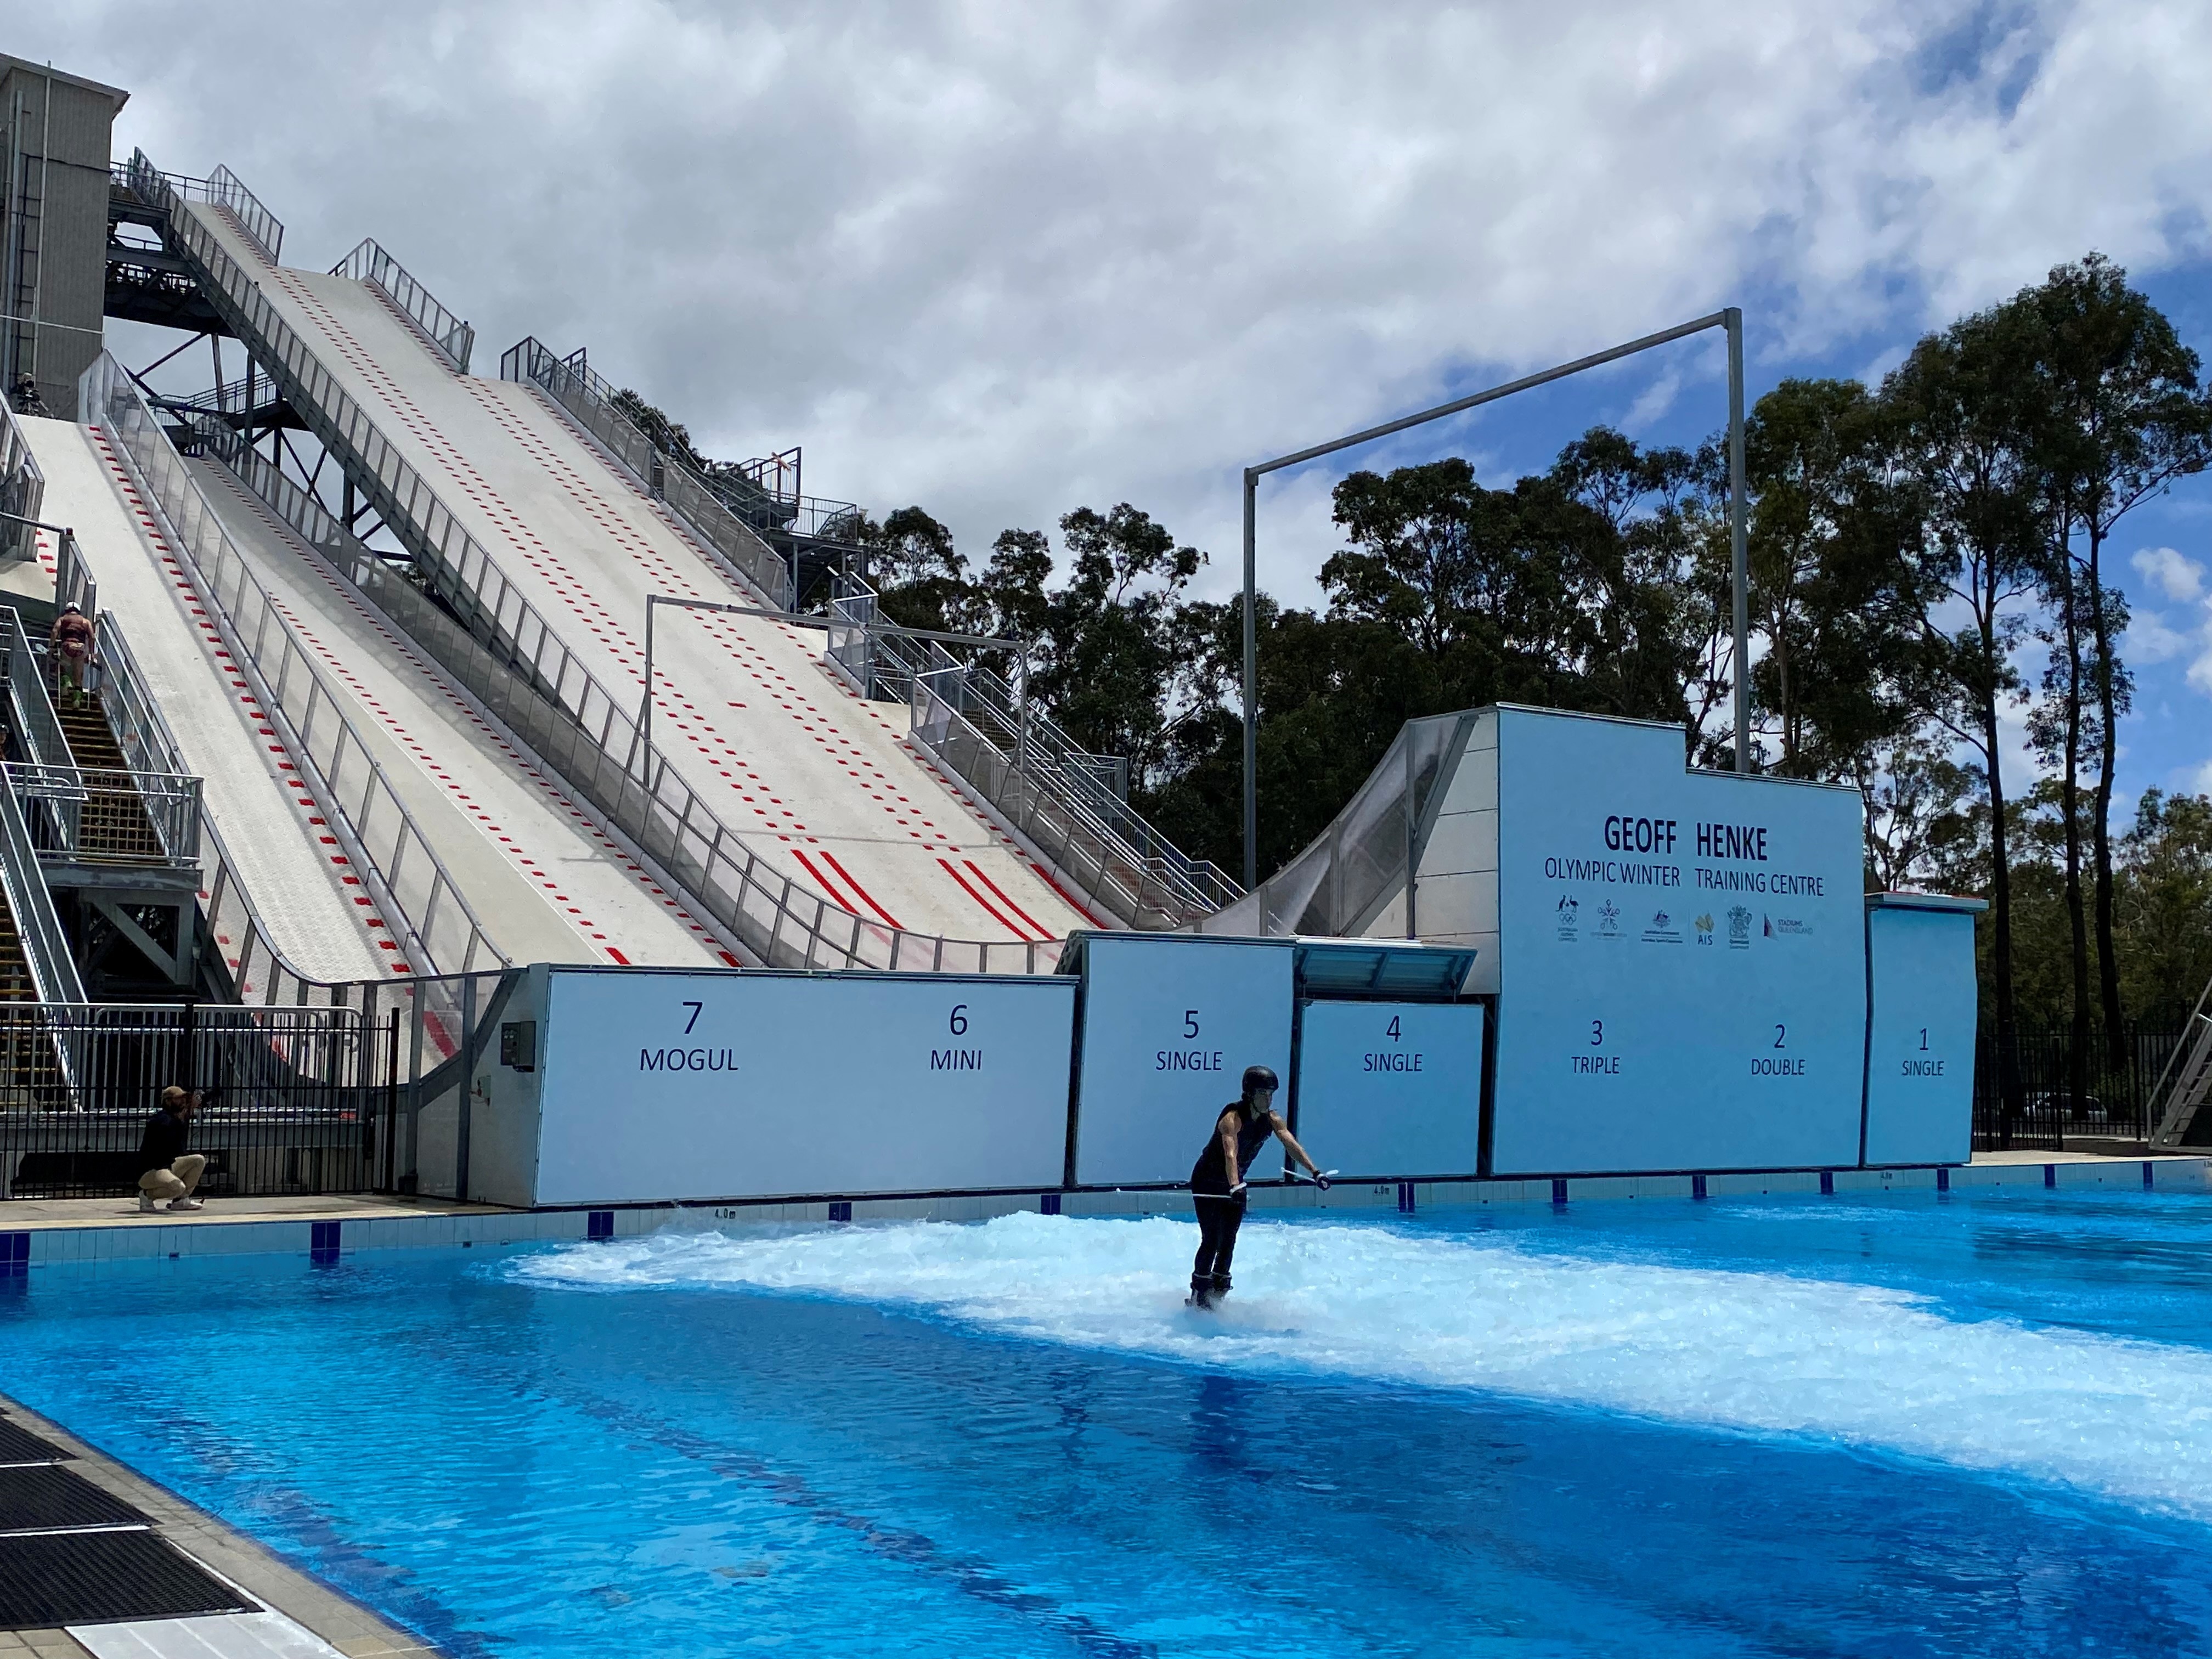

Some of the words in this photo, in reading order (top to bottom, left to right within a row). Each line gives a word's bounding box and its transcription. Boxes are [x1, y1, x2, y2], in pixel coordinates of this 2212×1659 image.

[1604, 815, 1677, 854] GEOFF
[1697, 822, 1768, 861] HENKE
[1545, 857, 1616, 883] OLYMPIC
[1620, 862, 1680, 887] WINTER
[1694, 868, 1766, 893] TRAINING
[1770, 874, 1824, 896] CENTRE
[1698, 934, 1713, 945] AIS
[682, 1001, 703, 1034] 7
[950, 1005, 968, 1036] 6
[1183, 1010, 1199, 1039] 5
[1386, 1015, 1402, 1042] 4
[1590, 1020, 1602, 1046] 3
[1774, 1024, 1785, 1048] 2
[1919, 1028, 1929, 1051] 1
[640, 1048, 738, 1071] MOGUL
[930, 1049, 982, 1070] MINI
[1155, 1051, 1223, 1071] SINGLE
[1363, 1053, 1423, 1072] SINGLE
[1571, 1056, 1620, 1074] TRIPLE
[1751, 1059, 1805, 1075] DOUBLE
[1901, 1060, 1944, 1076] SINGLE
